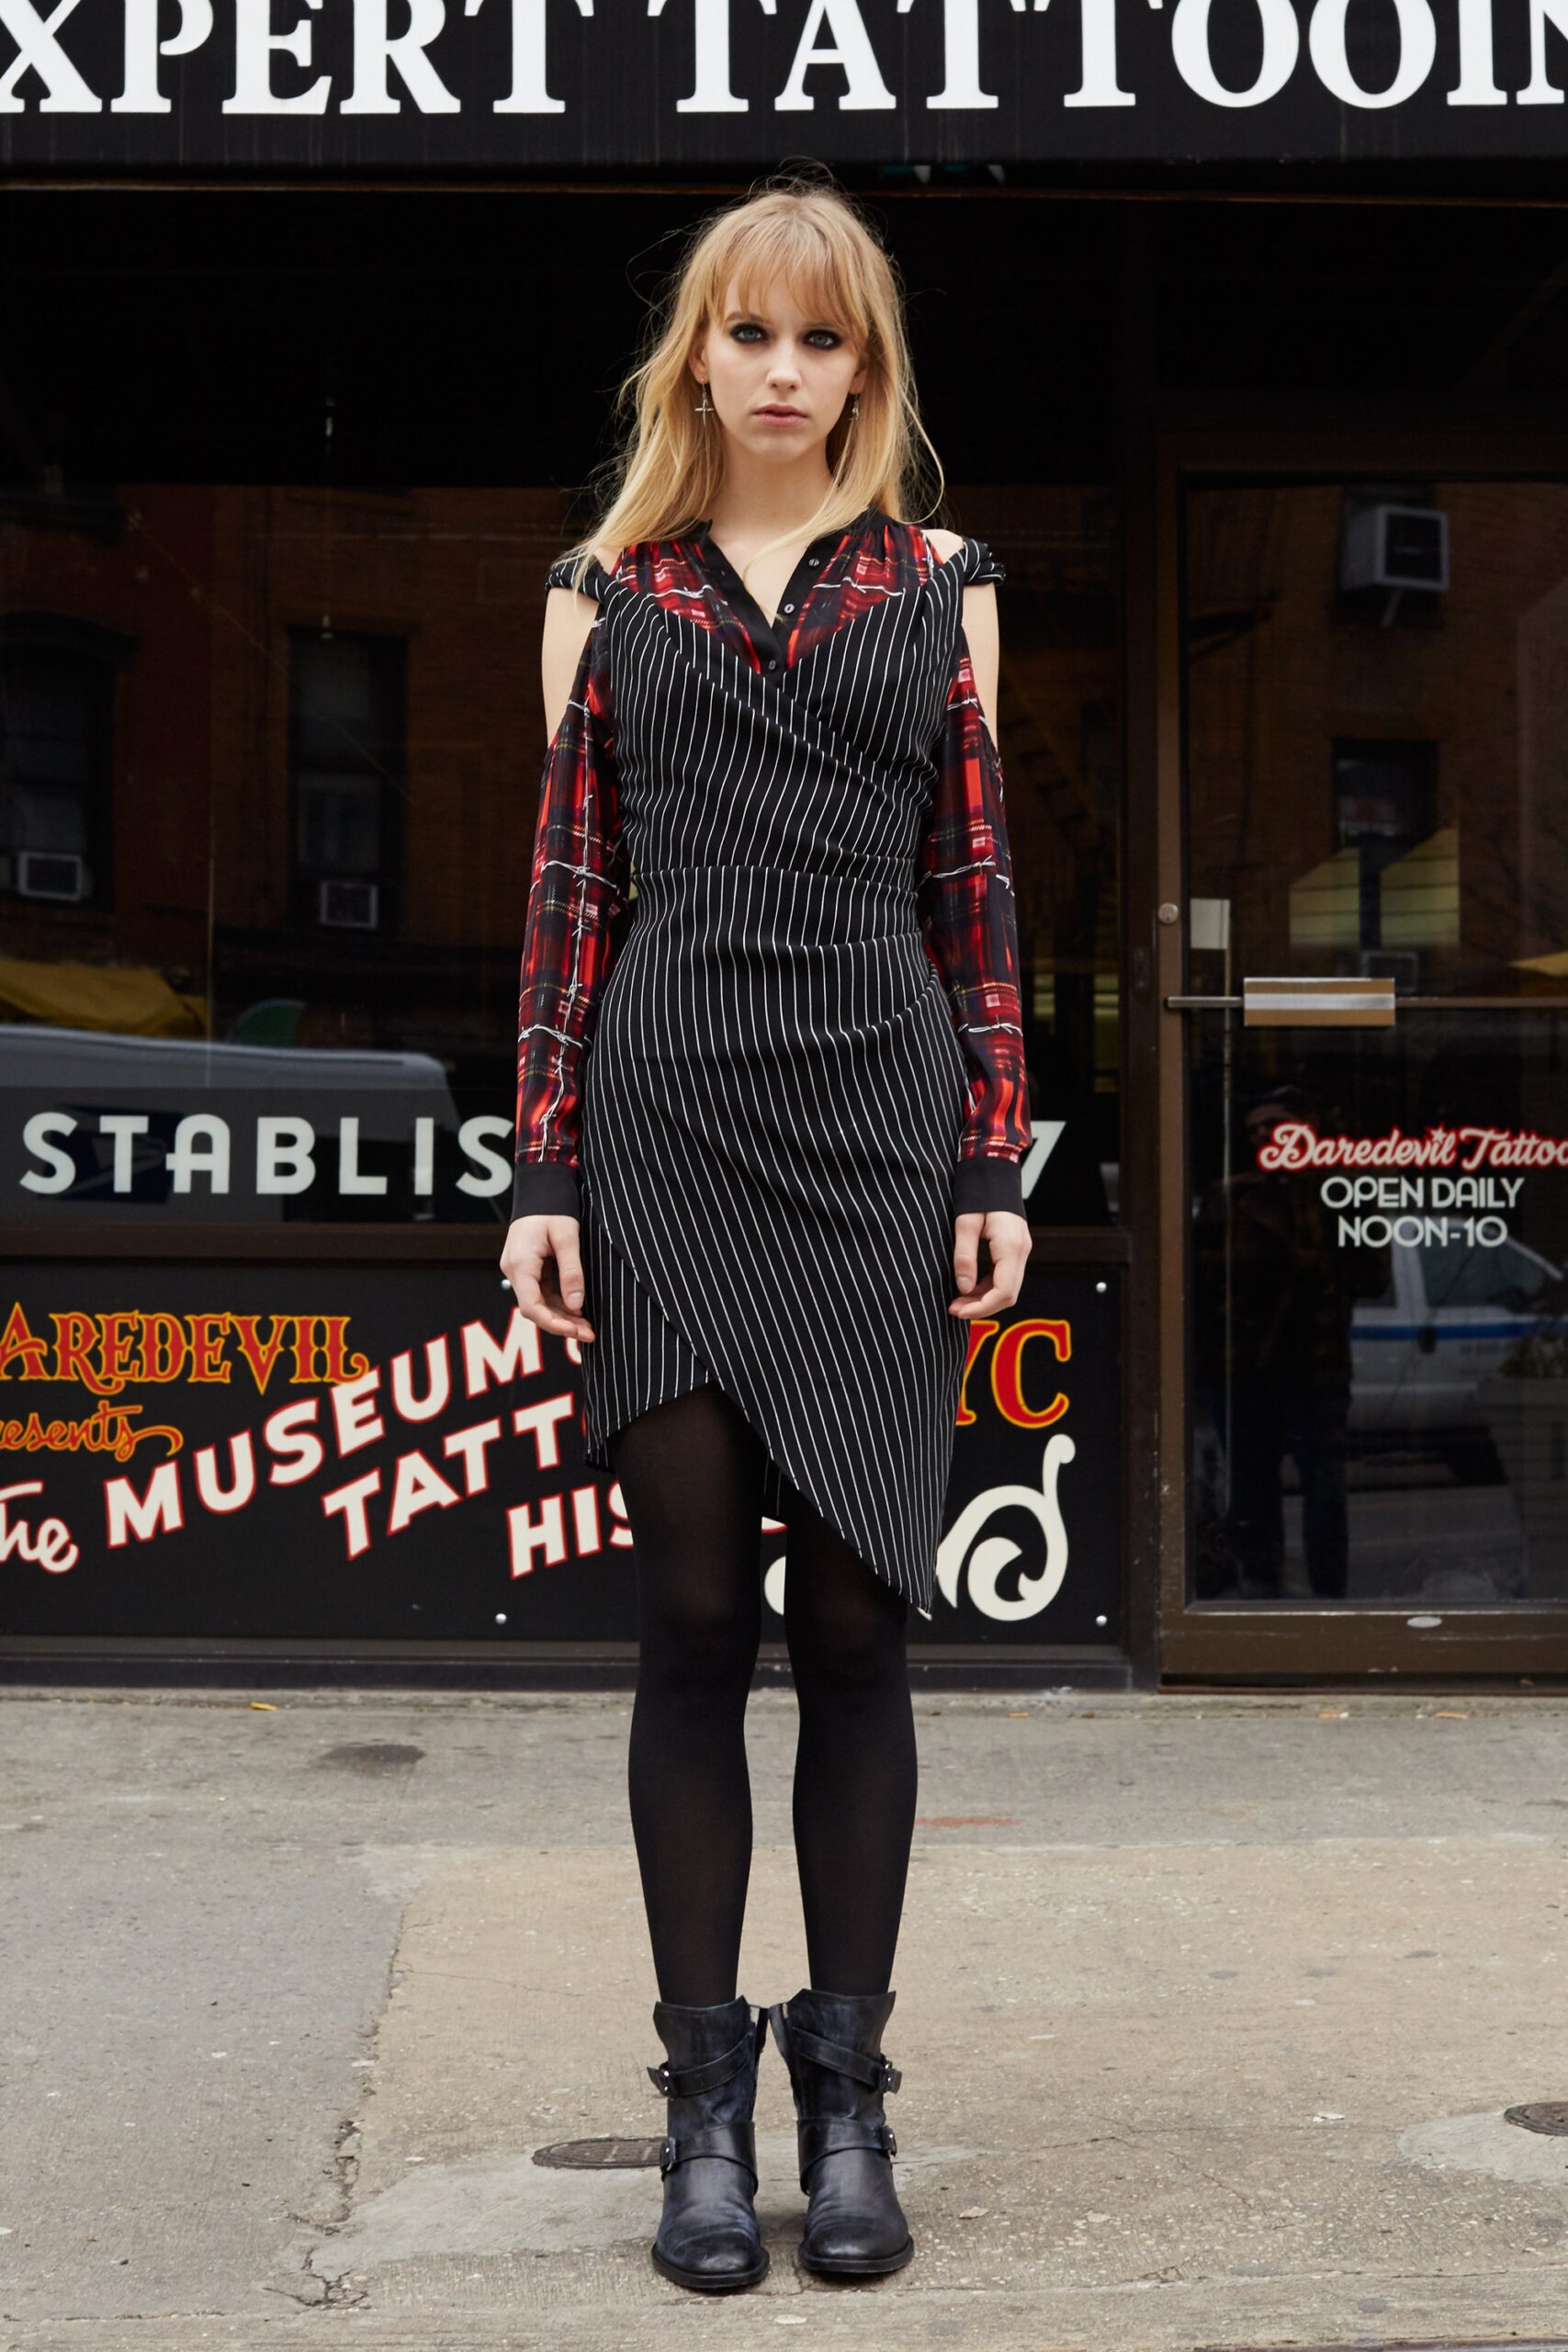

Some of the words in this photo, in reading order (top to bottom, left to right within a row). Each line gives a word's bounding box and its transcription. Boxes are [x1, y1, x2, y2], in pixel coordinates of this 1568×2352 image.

[0, 0, 593, 115] XPERT
[19, 1112, 515, 1197] STABLIS
[1257, 1122, 1458, 1171] Daredevil
[1320, 1175, 1424, 1208] OPEN
[1431, 1177, 1525, 1208] DAILY
[1337, 1215, 1508, 1248] NOON-10
[0, 1302, 369, 1395] AREDEVIL
[0, 1399, 184, 1463] esents
[103, 1306, 544, 1549] MUSEUM
[323, 1392, 587, 1561] TATT
